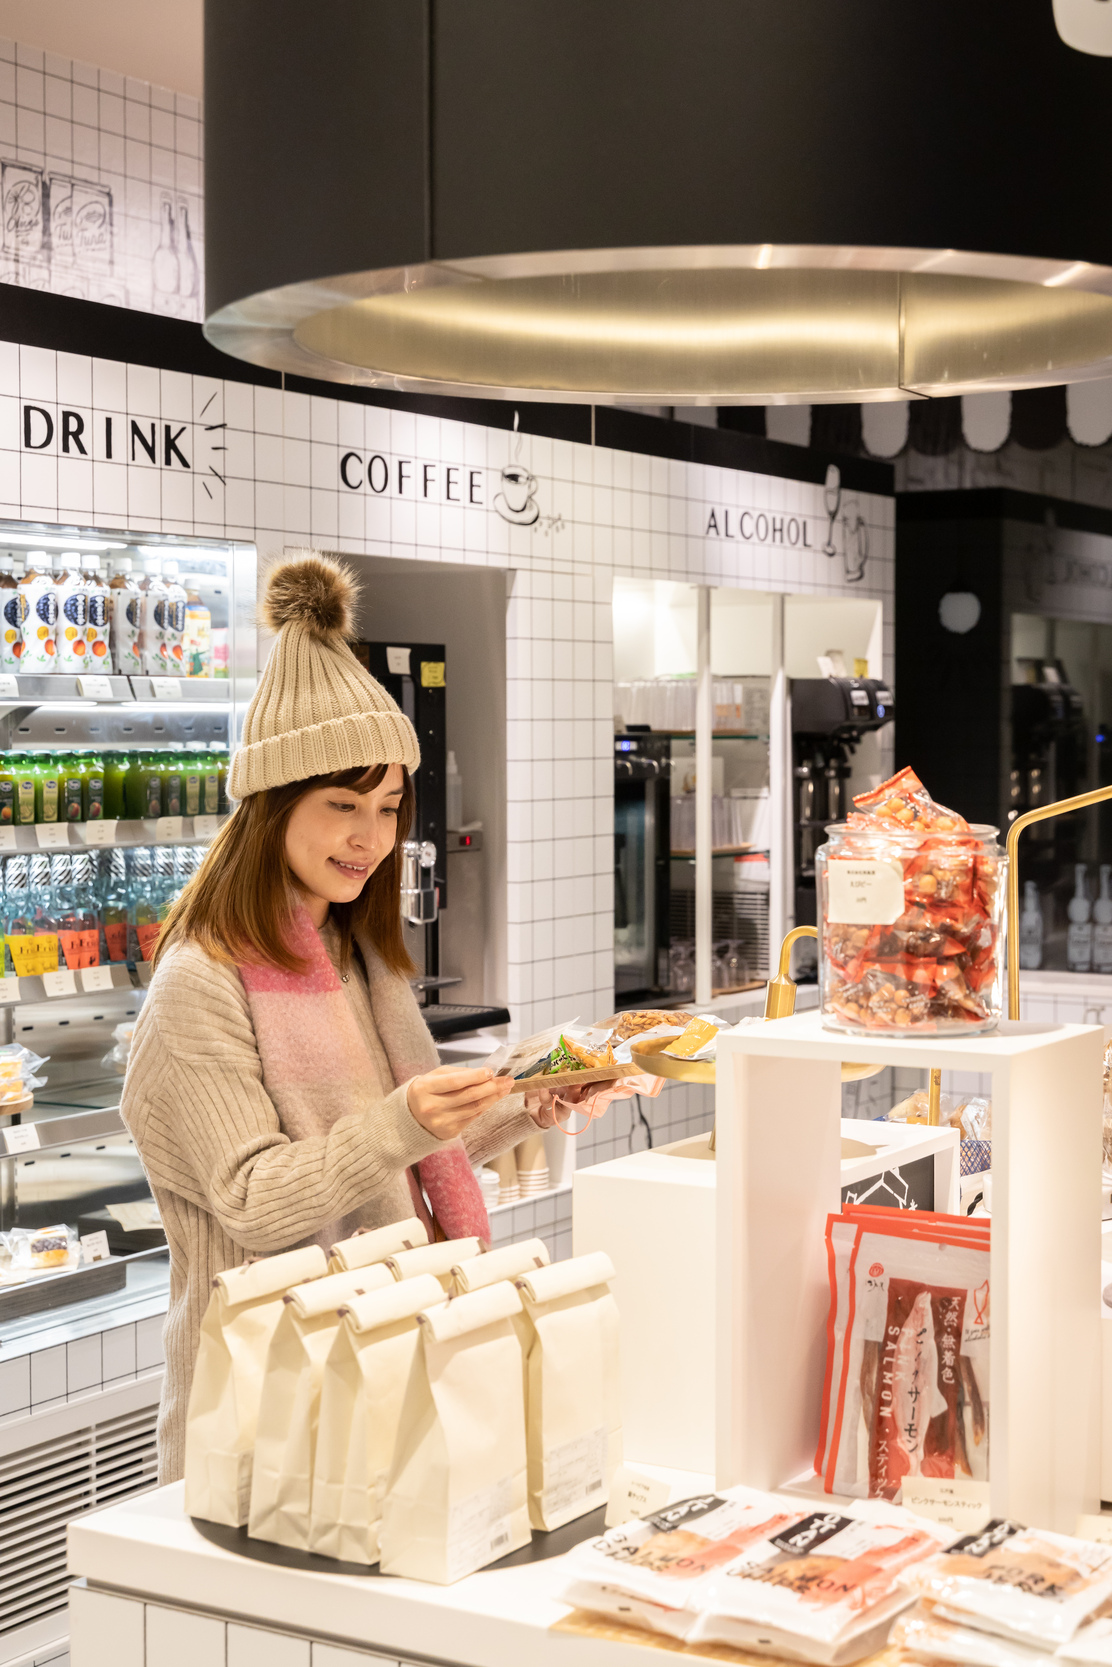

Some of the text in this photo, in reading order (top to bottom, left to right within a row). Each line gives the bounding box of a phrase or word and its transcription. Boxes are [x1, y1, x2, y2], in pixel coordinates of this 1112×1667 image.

[22, 404, 192, 470] DRINK
[339, 451, 485, 506] COFFEE
[704, 507, 813, 549] ALCOHOL
[895, 1327, 914, 1382] PINK
[940, 1296, 961, 1384] 天然・無着色
[879, 1325, 901, 1418] SALMON
[904, 1327, 928, 1454] ピンクサーモン
[911, 1496, 983, 1510] ピンクサーモンスティック
